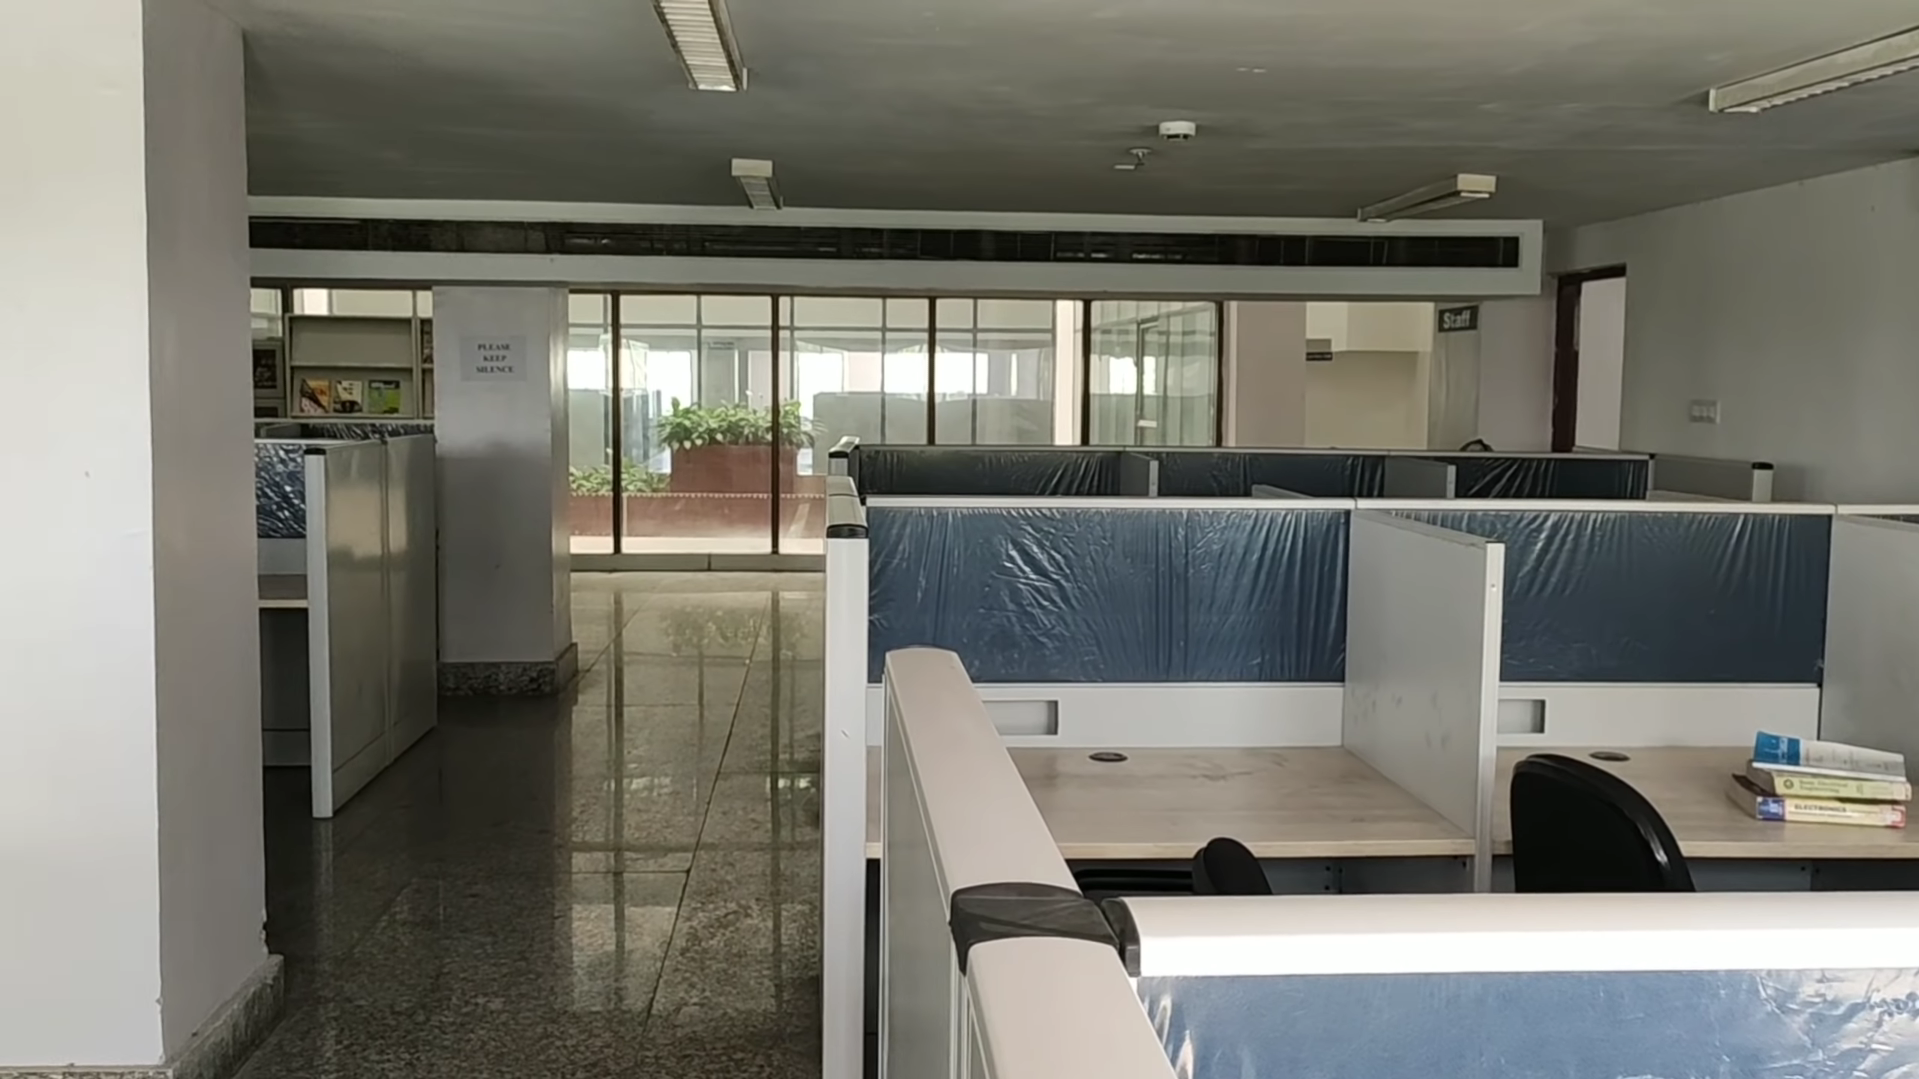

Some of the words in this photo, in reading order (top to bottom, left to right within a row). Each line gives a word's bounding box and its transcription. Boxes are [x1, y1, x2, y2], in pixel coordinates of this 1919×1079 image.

[1443, 310, 1471, 329] Staff
[477, 343, 511, 351] PLEASE
[483, 354, 507, 362] KEEP
[476, 365, 515, 374] SILENCE
[1794, 803, 1847, 813] ELECTRONICS
